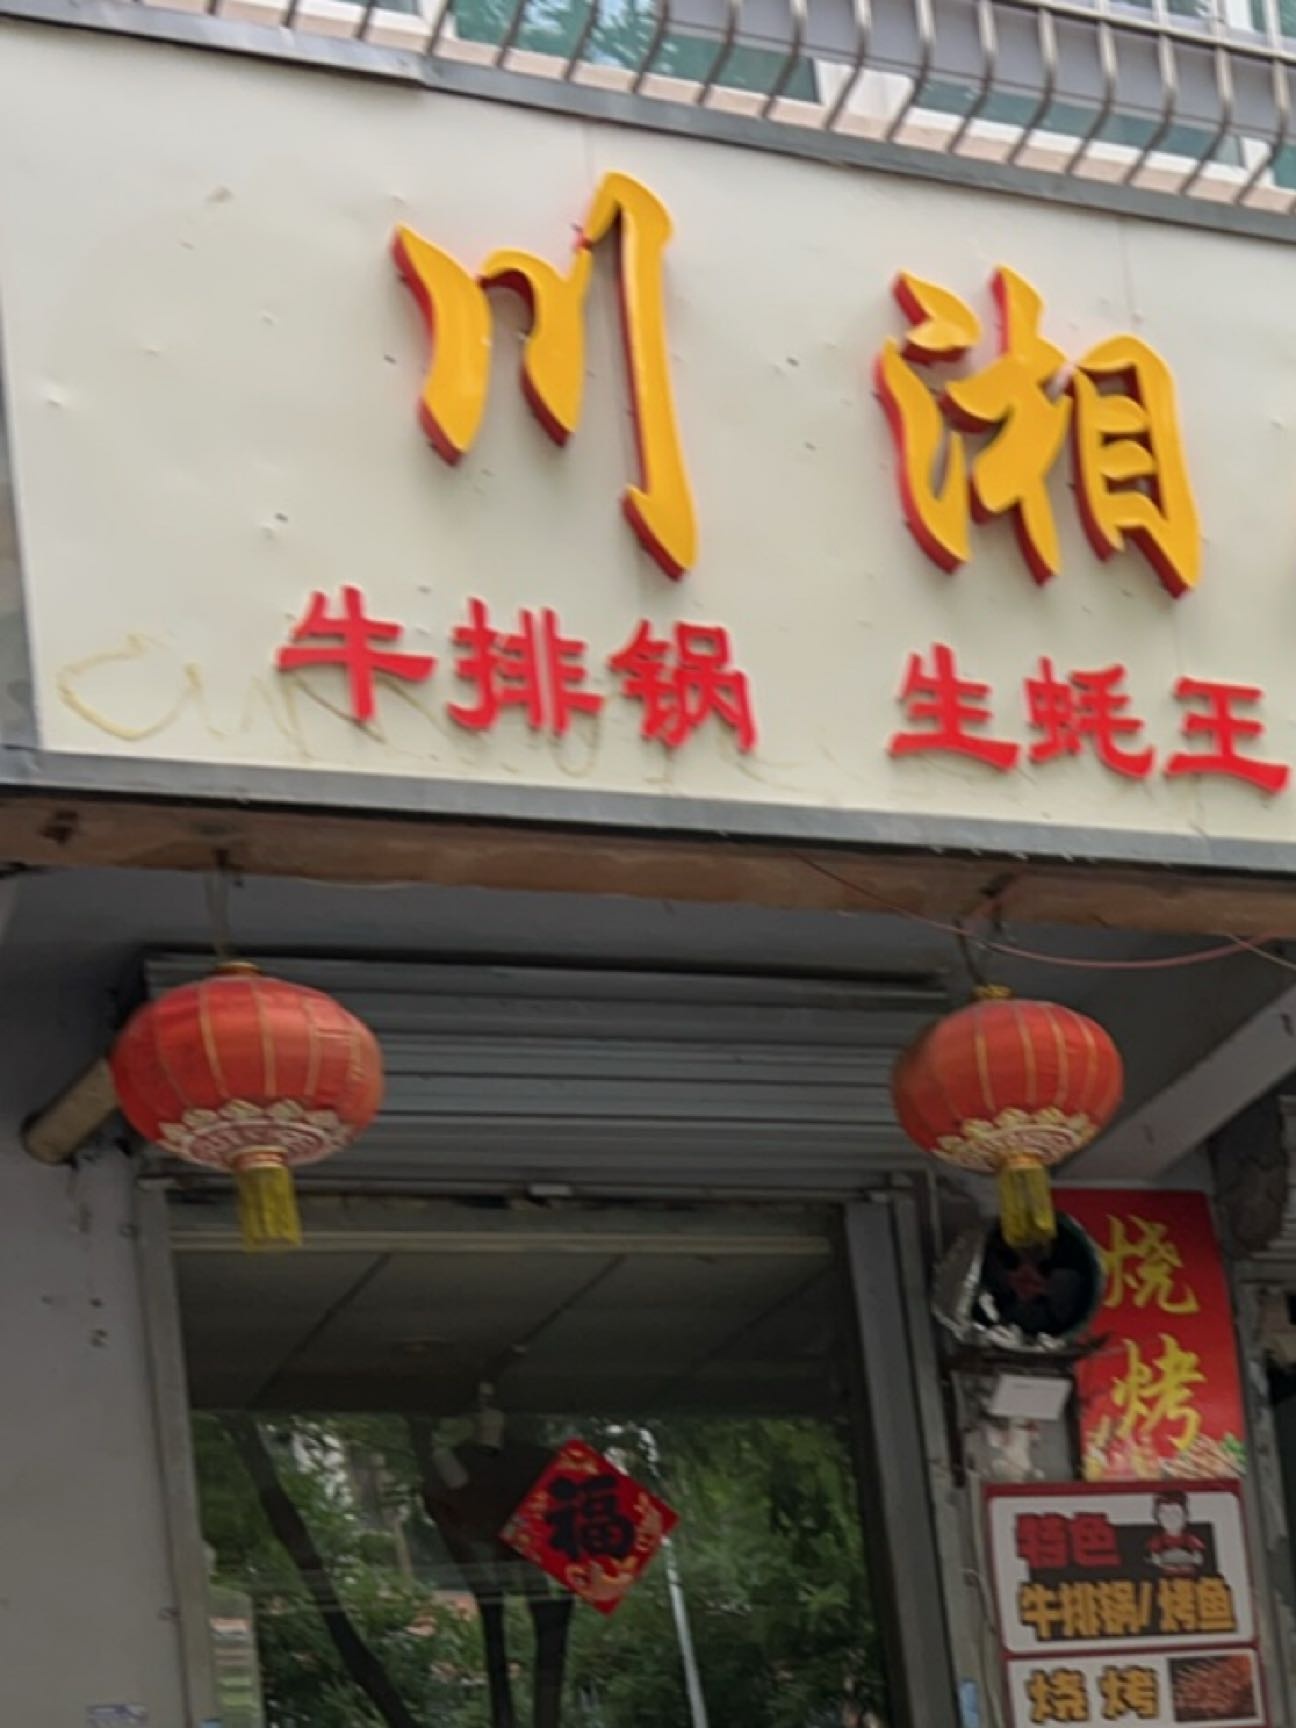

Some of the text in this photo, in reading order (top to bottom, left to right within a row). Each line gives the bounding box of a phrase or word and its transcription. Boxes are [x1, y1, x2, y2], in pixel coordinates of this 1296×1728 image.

[277, 584, 757, 754] 牛排锅
[889, 642, 1290, 796] 生蚝王
[548, 1474, 637, 1563] 福
[1016, 1512, 1122, 1570] 特色
[1026, 1664, 1159, 1724] 烧烤
